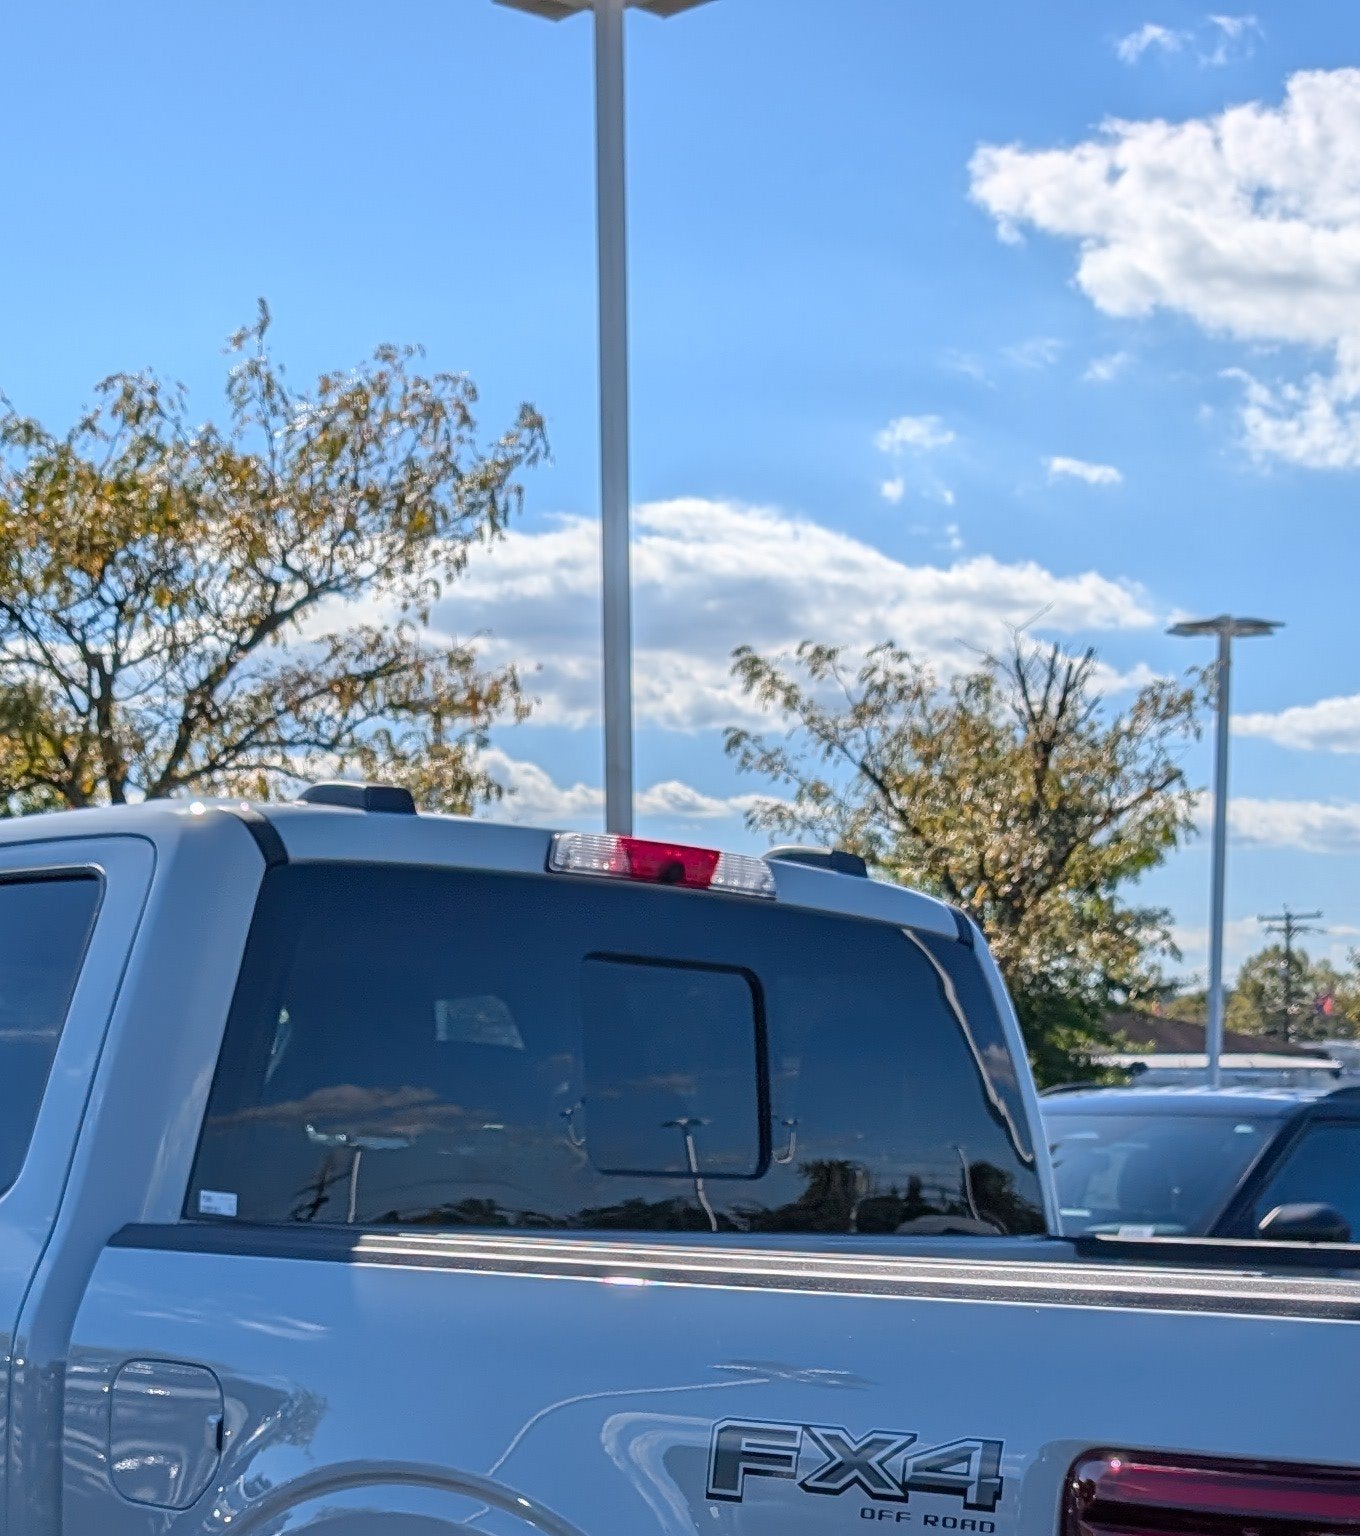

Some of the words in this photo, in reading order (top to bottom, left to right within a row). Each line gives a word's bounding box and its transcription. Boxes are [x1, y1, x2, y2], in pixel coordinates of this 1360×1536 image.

[706, 1416, 1005, 1513] FX4
[859, 1507, 912, 1523] OFF
[922, 1514, 996, 1534] ROAD
